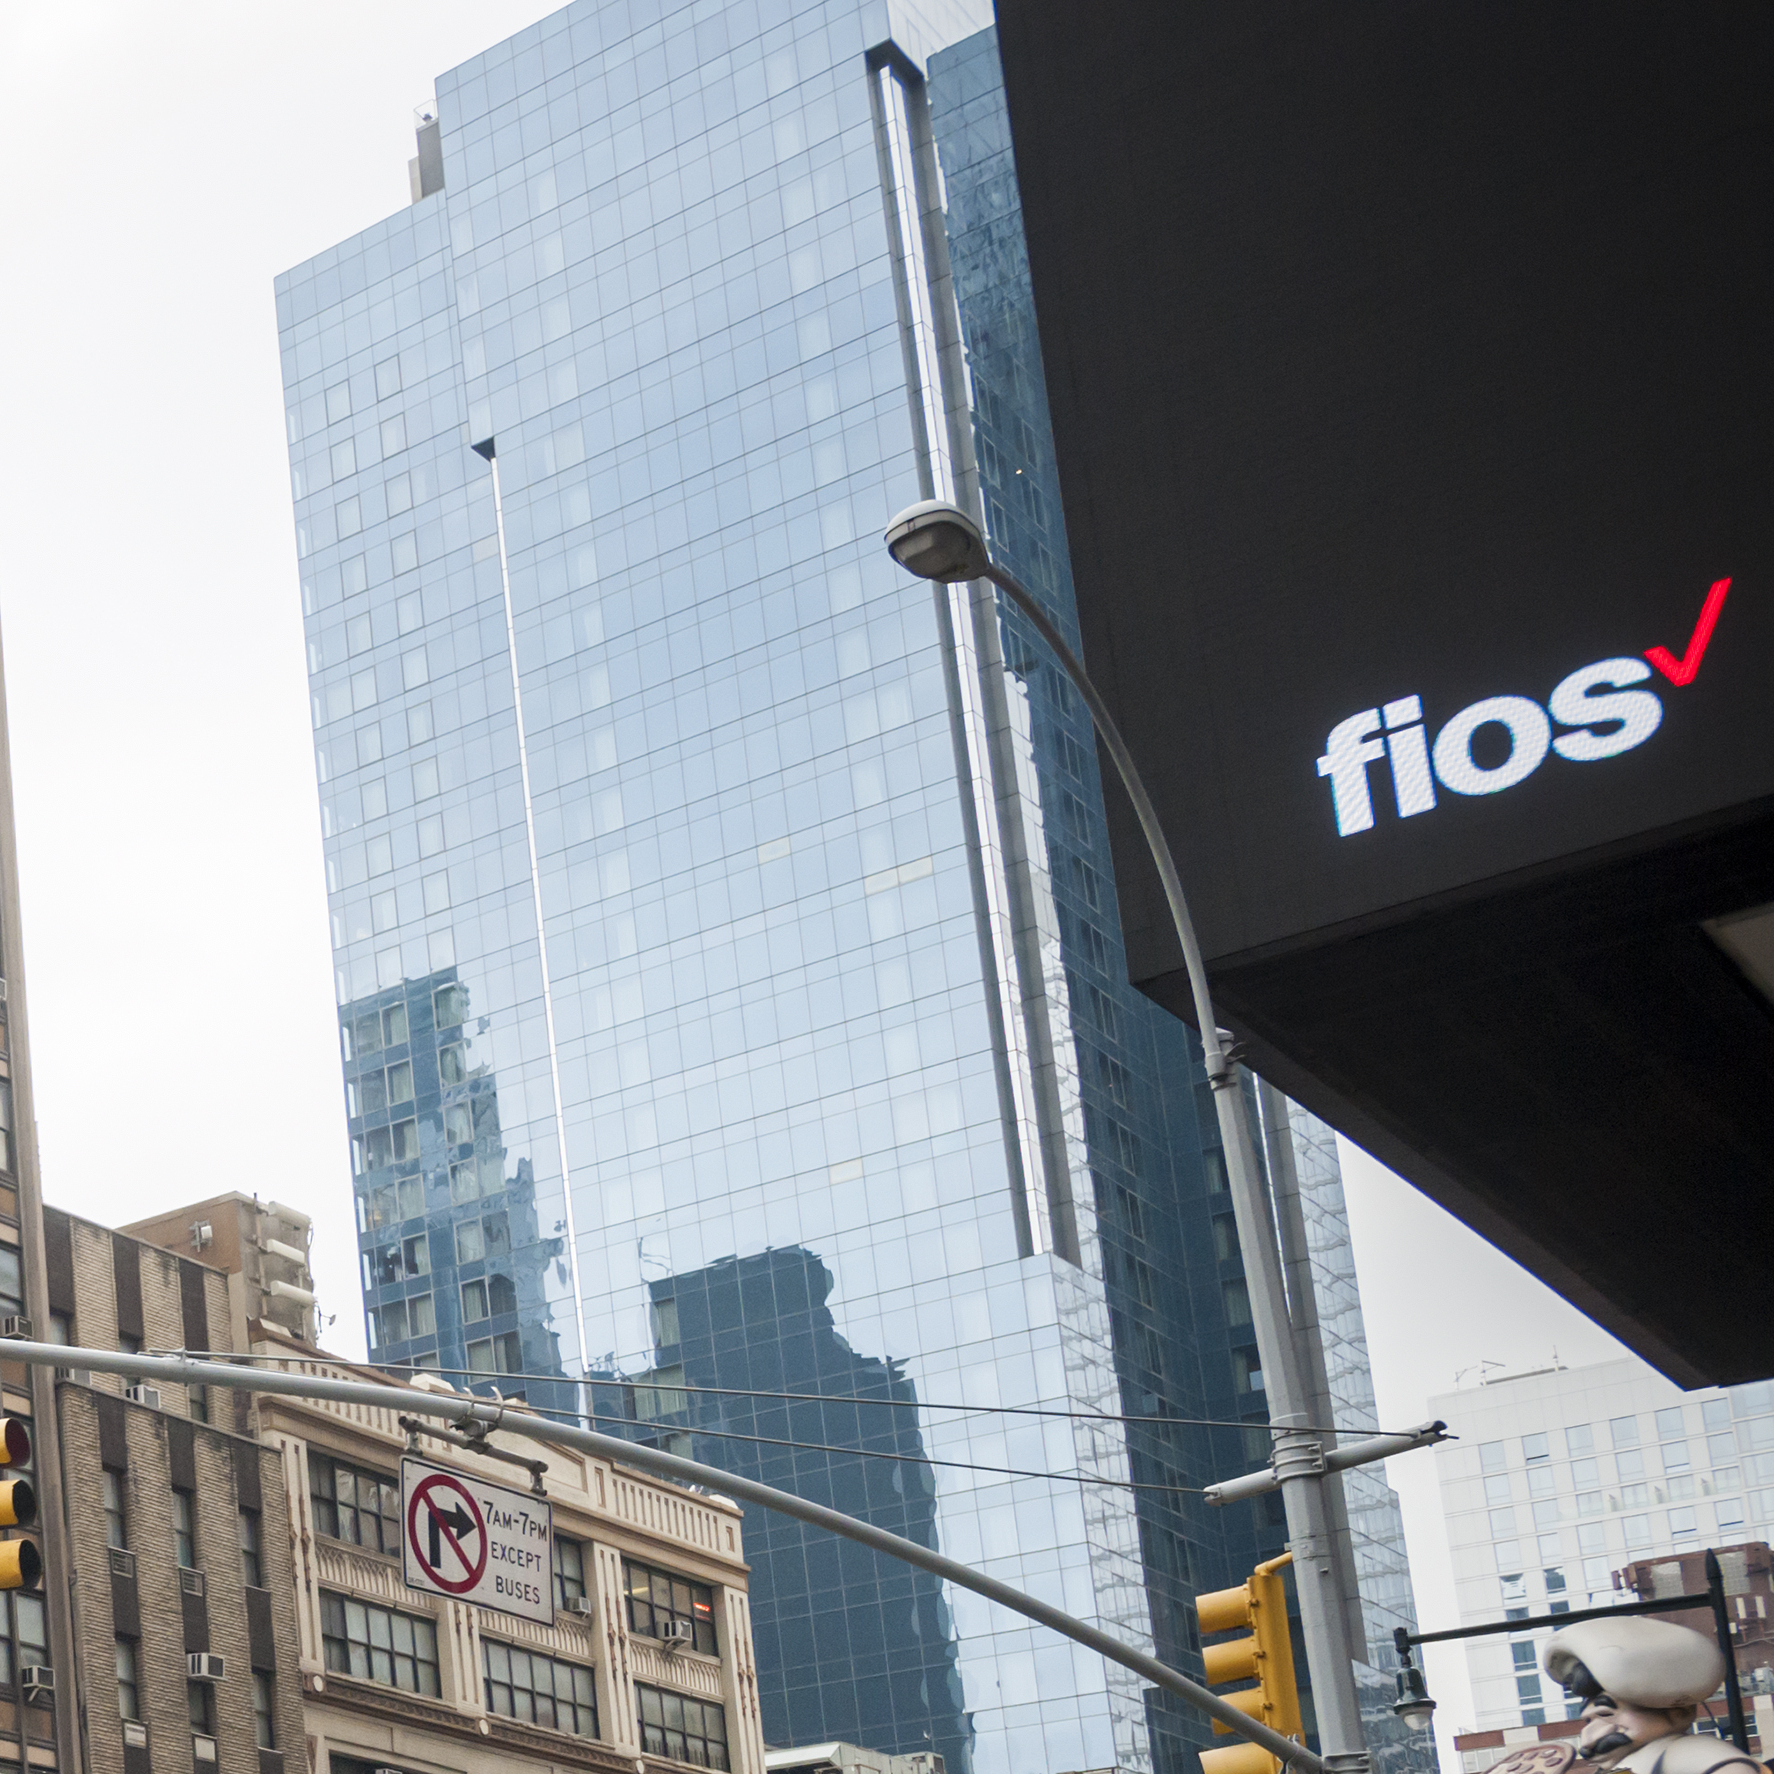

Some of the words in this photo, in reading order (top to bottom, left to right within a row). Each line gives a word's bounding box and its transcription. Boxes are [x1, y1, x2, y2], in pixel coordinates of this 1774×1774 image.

[1316, 656, 1664, 837] fios
[483, 1500, 548, 1542] 7AM-7PM
[491, 1541, 542, 1572] EXCEPT
[495, 1575, 540, 1605] BUSES
